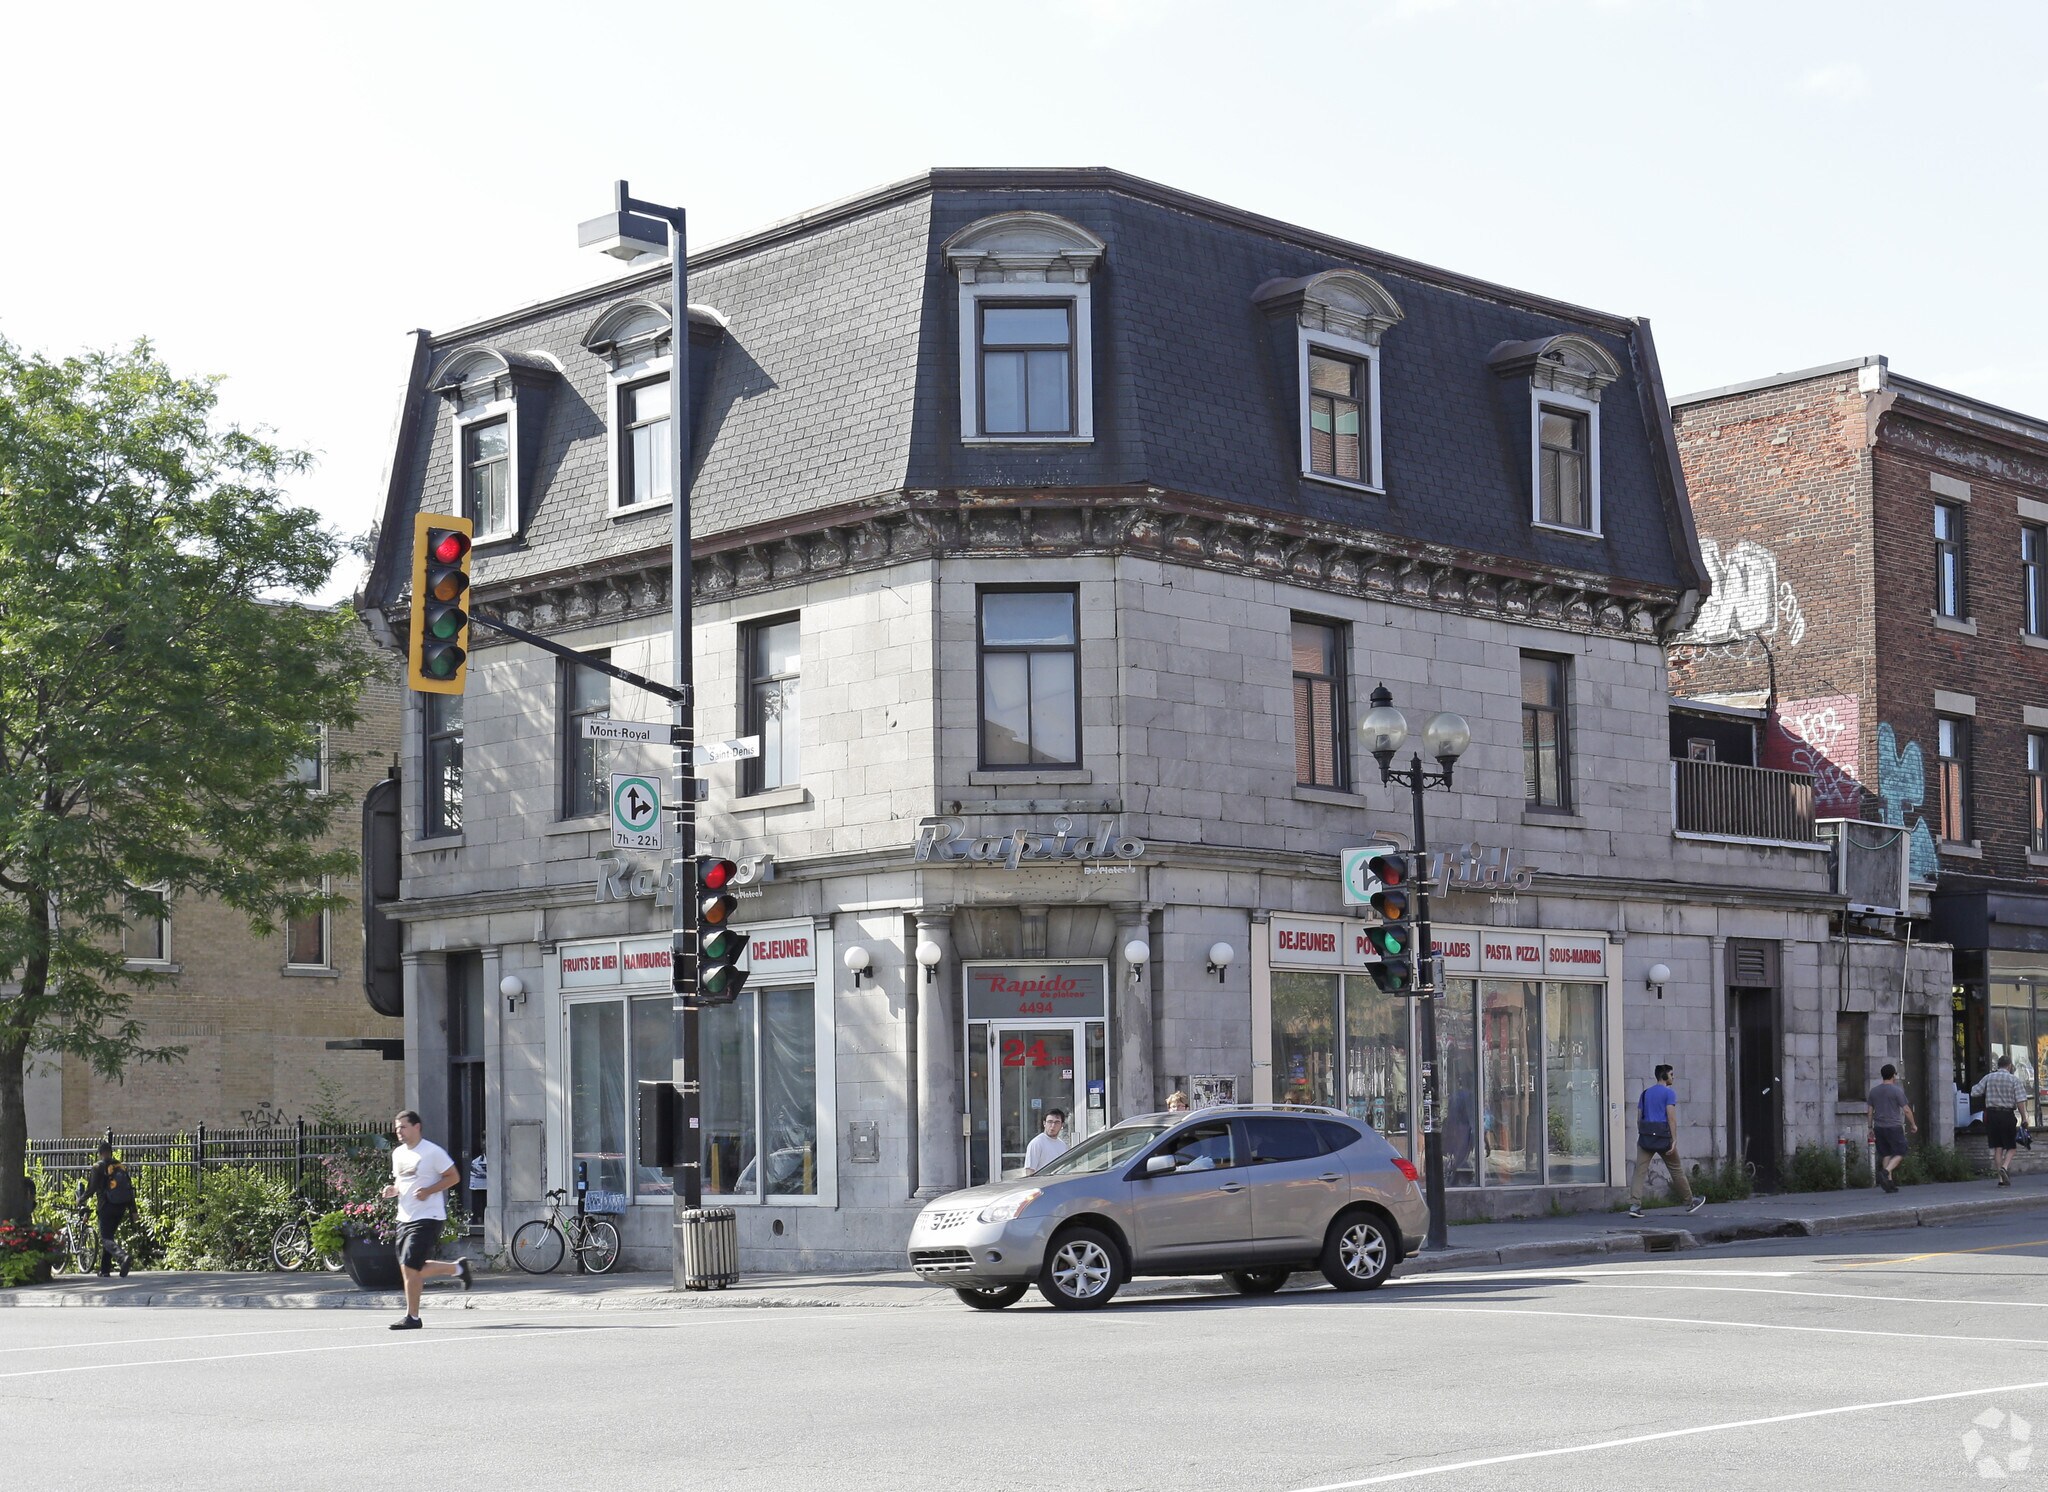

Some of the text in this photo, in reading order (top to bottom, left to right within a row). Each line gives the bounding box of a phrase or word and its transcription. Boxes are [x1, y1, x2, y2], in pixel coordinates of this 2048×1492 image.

[589, 725, 650, 741] Mont-Royal
[709, 746, 755, 762] Saint-Denis
[617, 833, 629, 845] 7h
[637, 834, 658, 847] 22h
[914, 816, 1146, 871] Rapido
[752, 938, 808, 961] DEJEUNER
[1279, 930, 1336, 952] DEJEUNER
[1486, 944, 1541, 962] PASTA PIZZA
[1550, 947, 1602, 964] SOUS-MARINS
[563, 955, 618, 973] FRUITS DE MER
[990, 974, 1077, 997] Rapido
[1017, 1001, 1053, 1014] 4494
[1002, 1038, 1051, 1067] 24
